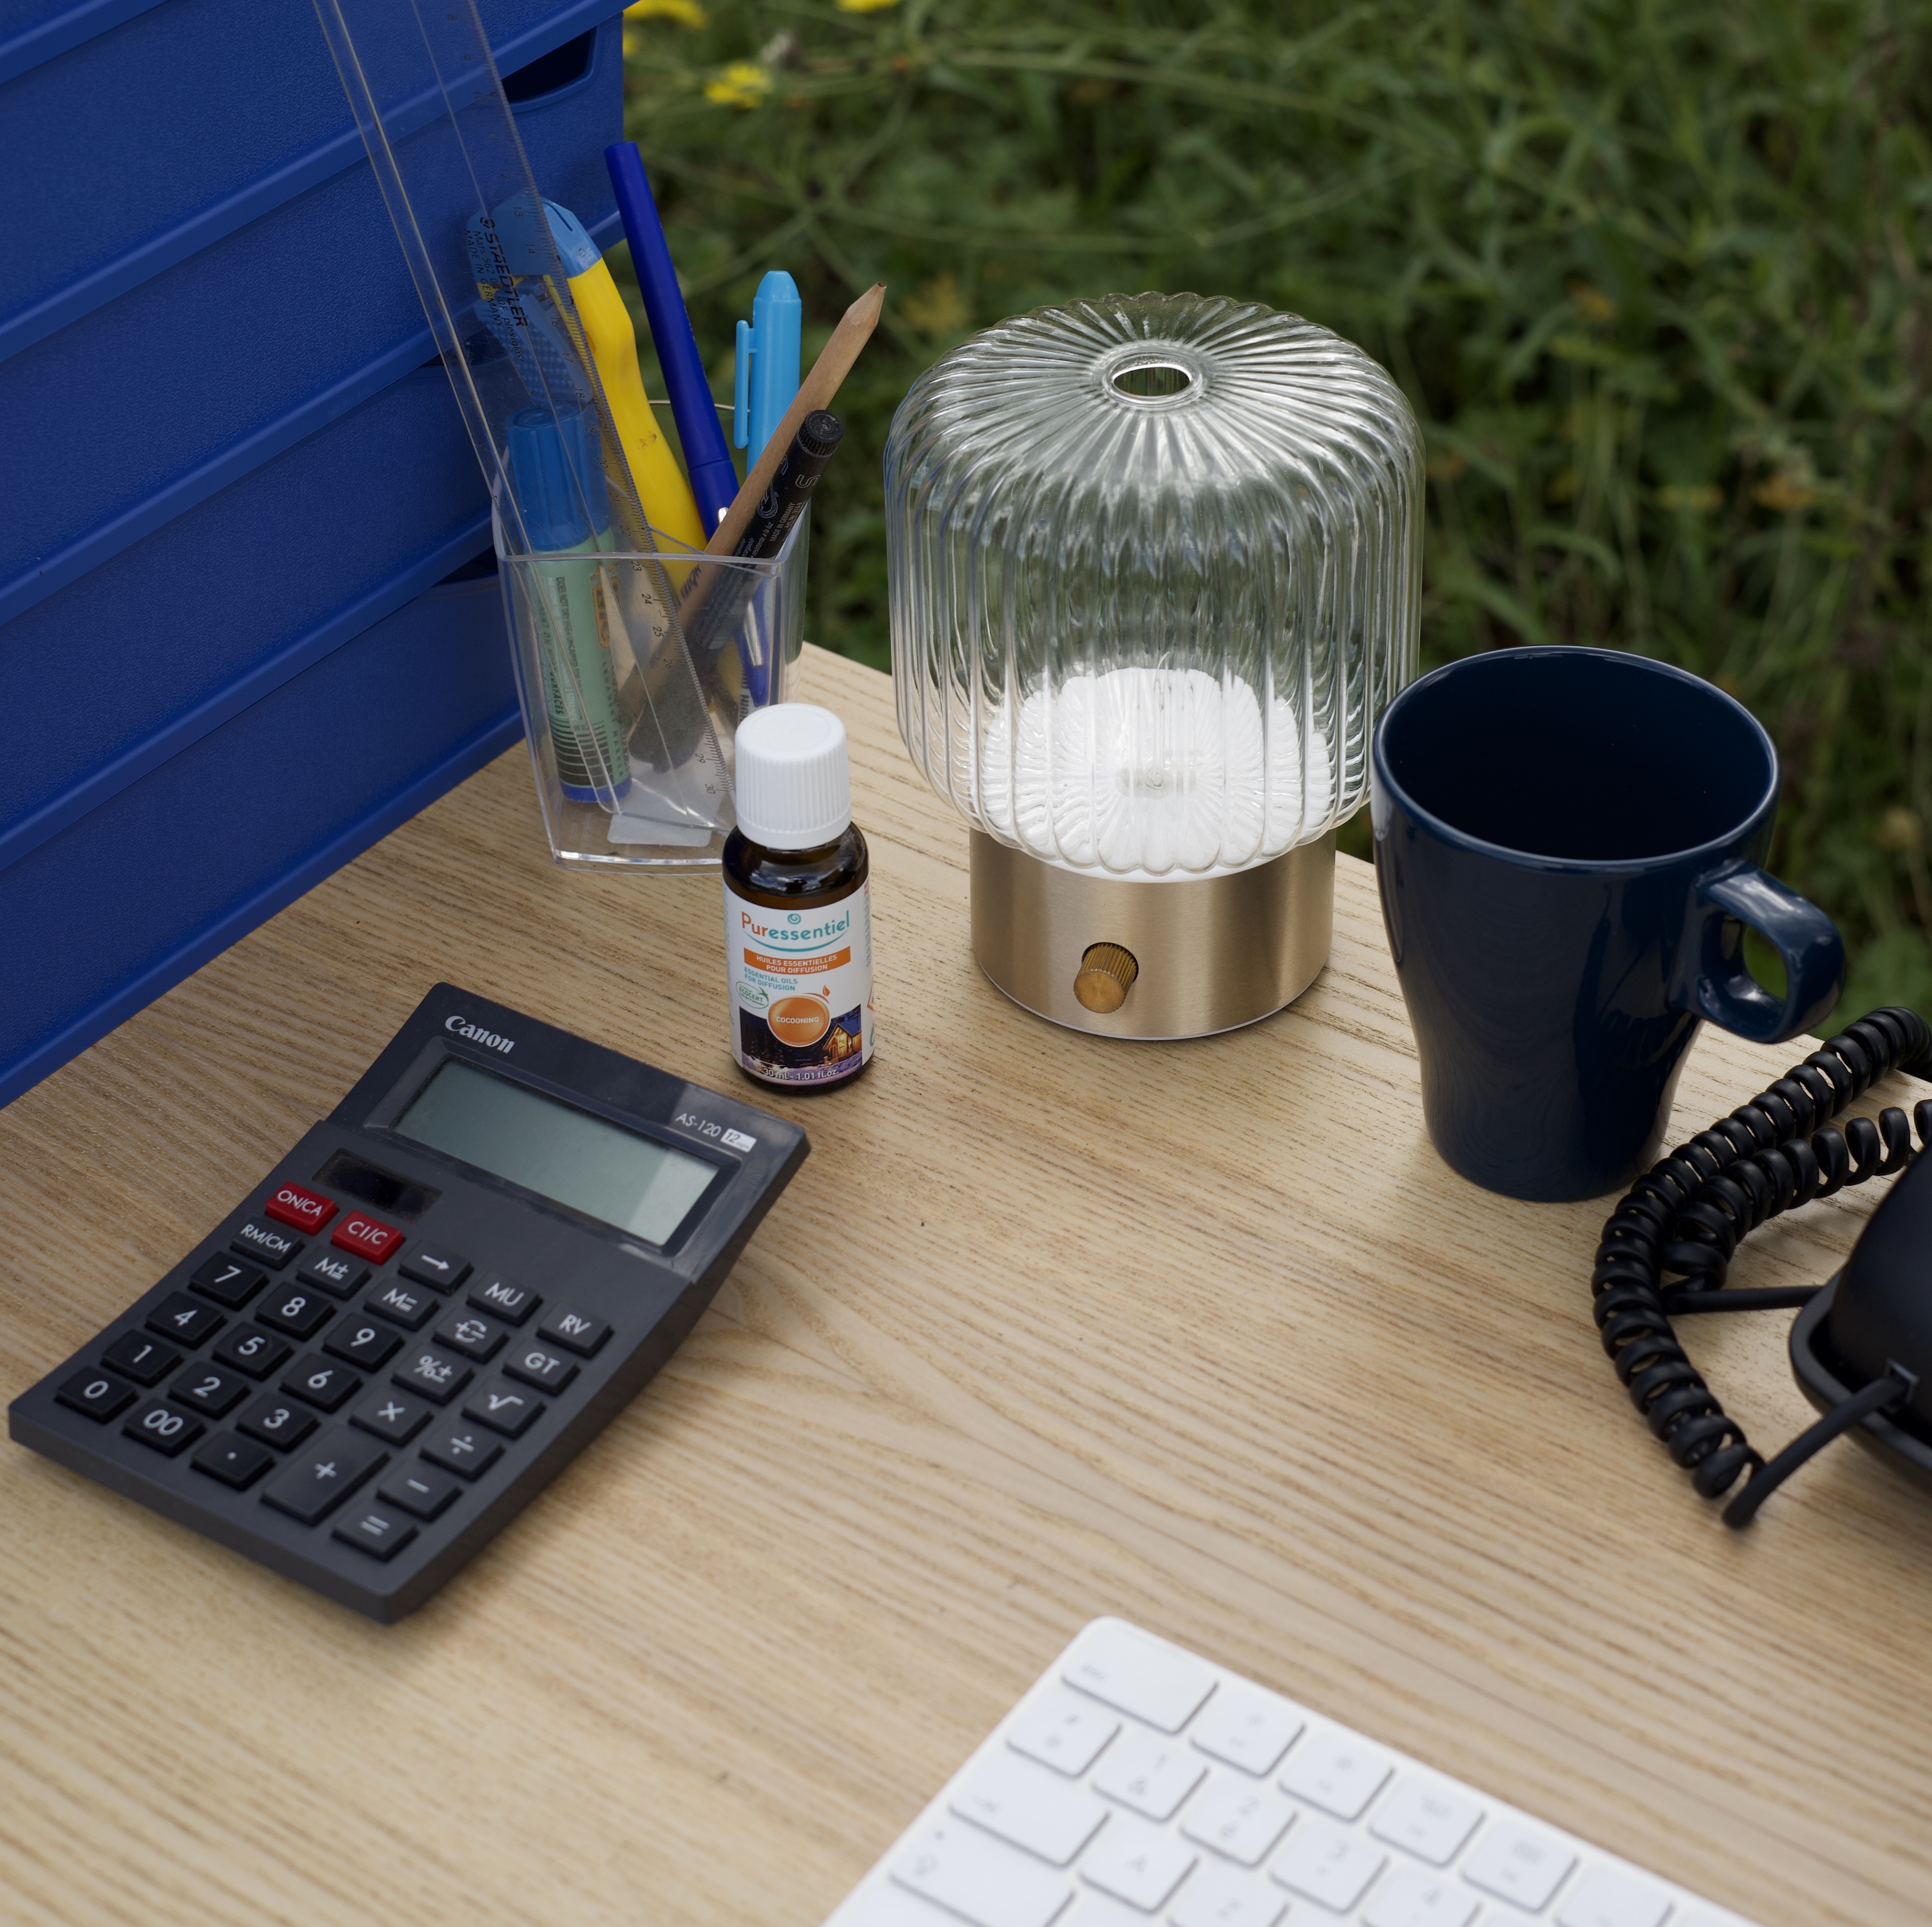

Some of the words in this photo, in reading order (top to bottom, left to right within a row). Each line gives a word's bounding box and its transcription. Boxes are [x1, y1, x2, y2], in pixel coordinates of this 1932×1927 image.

[513, 206, 524, 217] 13
[473, 231, 486, 254] Mars
[483, 258, 495, 274] 562
[526, 243, 536, 254] 14
[464, 230, 480, 259] MADE
[475, 264, 485, 274] IN
[481, 278, 504, 328] GERMANY
[484, 233, 528, 327] STAEDTLER
[550, 316, 559, 327] 16
[563, 353, 574, 363] 17
[574, 389, 585, 398] 18
[587, 424, 597, 433] 19
[597, 458, 609, 468] 20
[610, 492, 620, 502] 21
[769, 530, 781, 541] MADE
[780, 502, 796, 524] GERMANY
[631, 561, 642, 571] 23
[641, 594, 651, 604] 24
[652, 626, 664, 637] 25
[696, 753, 706, 764] 29
[705, 783, 716, 794] 30
[741, 910, 850, 940] Puressentiel
[756, 954, 782, 966] HUILES
[783, 953, 838, 967] ESSENTIELLES
[766, 964, 786, 973] POUR
[787, 964, 828, 974] DIFFUSION
[744, 967, 780, 983] ESSENTIAL
[744, 973, 756, 984] FOR
[757, 979, 796, 991] DIFFUSION
[739, 986, 763, 1003] ECOCERT
[445, 1016, 515, 1053] Canon
[764, 1067, 773, 1077] 30
[797, 1072, 815, 1080] 1.01
[676, 1113, 722, 1137] AS-120
[725, 1131, 740, 1143] 12
[277, 1190, 323, 1217] ON/CA
[241, 1224, 292, 1253] RM/CM
[214, 1265, 242, 1283] 7
[484, 1282, 525, 1307] MU
[282, 1297, 306, 1317] 8
[173, 1309, 198, 1326] 4
[559, 1314, 591, 1335] RV
[238, 1336, 265, 1355] 5
[351, 1328, 376, 1346] 9
[133, 1345, 153, 1363] 1
[524, 1352, 560, 1374] GT
[194, 1376, 221, 1397] 2
[308, 1370, 334, 1389] 6
[84, 1380, 109, 1399] 0
[144, 1409, 184, 1436] 00
[264, 1408, 290, 1429] 3
